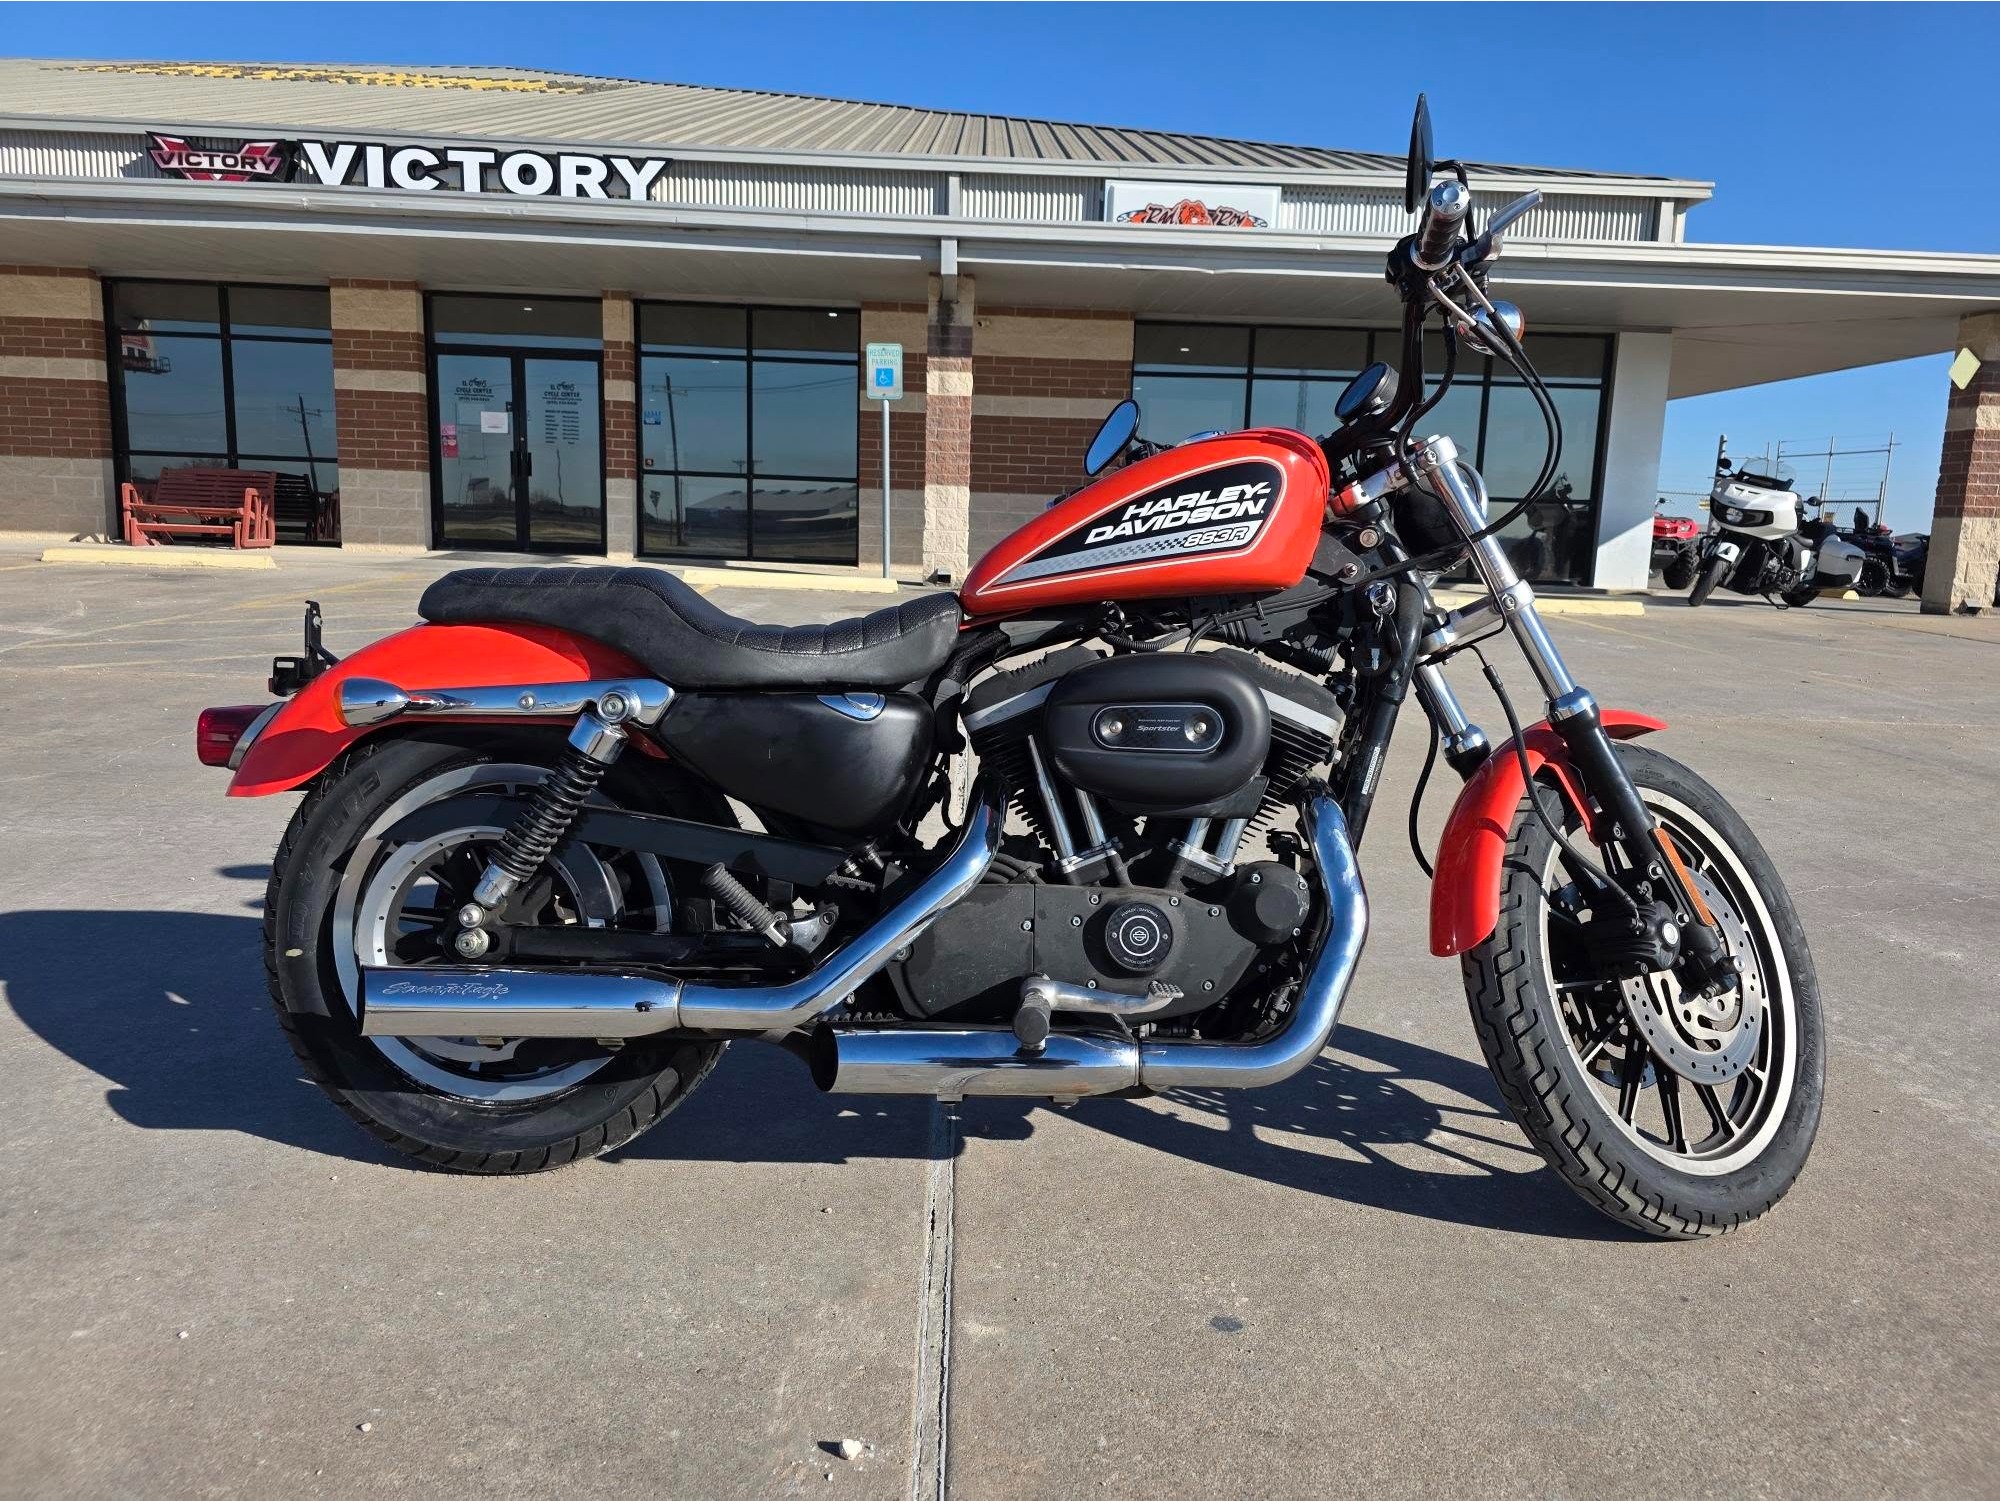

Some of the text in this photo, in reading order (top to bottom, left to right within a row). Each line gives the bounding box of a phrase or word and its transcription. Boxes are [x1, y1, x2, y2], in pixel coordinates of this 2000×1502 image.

[157, 151, 276, 171] VICTORY
[301, 142, 667, 200] VICTORY
[869, 349, 900, 357] RESERVED
[871, 358, 899, 366] PARKING
[1122, 481, 1271, 521] HARLEY-
[1085, 499, 1267, 544] DAVIDSON
[1183, 525, 1250, 548] 883R
[1136, 724, 1182, 732] Sportster
